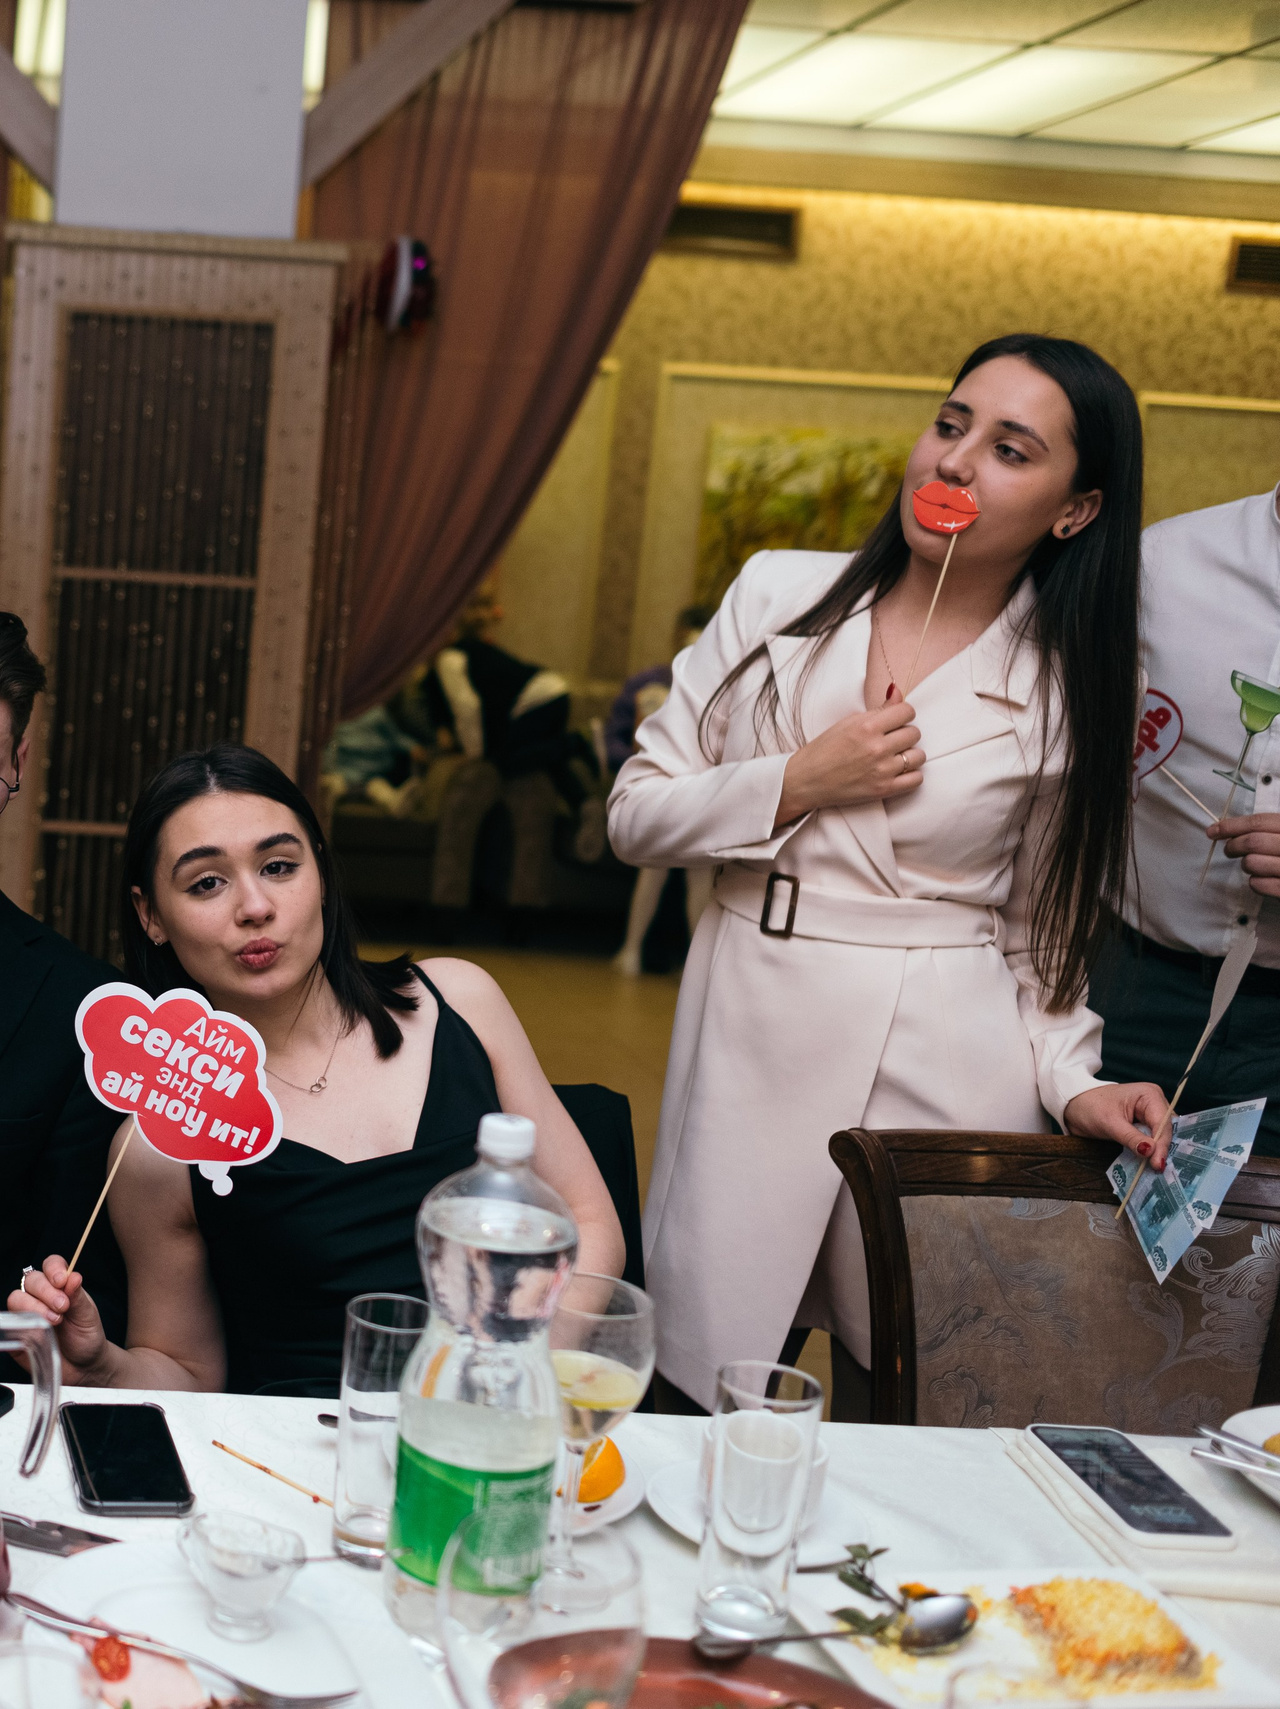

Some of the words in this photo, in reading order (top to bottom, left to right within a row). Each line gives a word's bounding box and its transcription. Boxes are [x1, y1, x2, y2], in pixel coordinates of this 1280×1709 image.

[120, 1015, 245, 1099] секси
[183, 1016, 247, 1064] Айм
[101, 1070, 144, 1103] ай
[144, 1089, 207, 1137] ноу
[208, 1118, 261, 1154] ит!
[156, 1067, 204, 1105] энд
